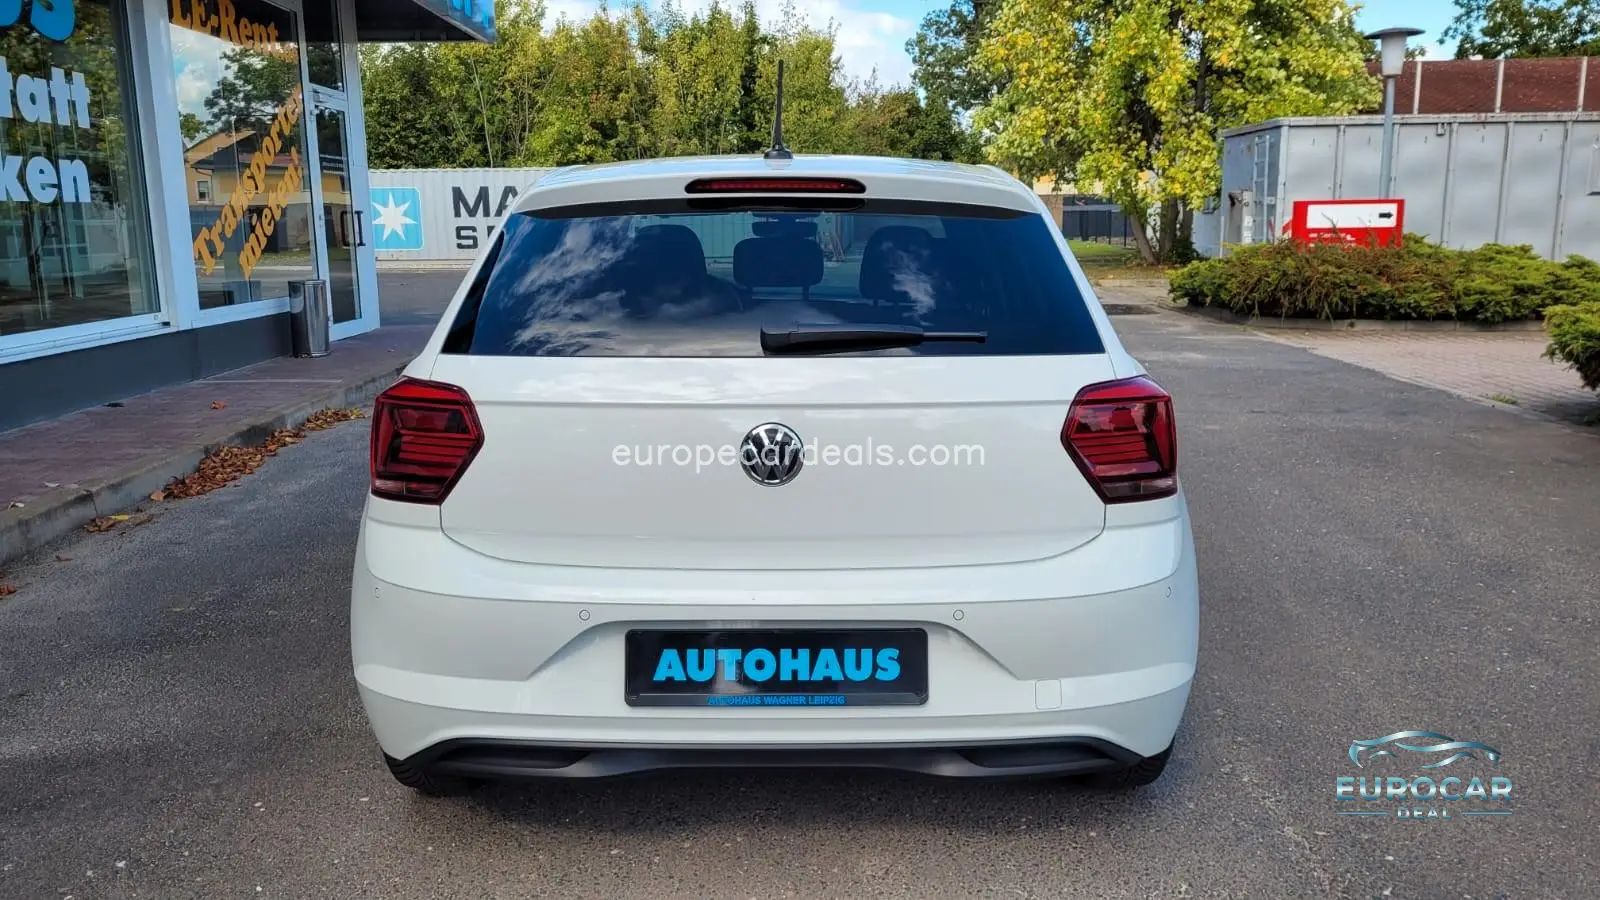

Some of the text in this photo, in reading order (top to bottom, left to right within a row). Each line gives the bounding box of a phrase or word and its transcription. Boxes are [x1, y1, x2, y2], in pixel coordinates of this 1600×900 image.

[193, 83, 304, 275] Transporter
[239, 146, 304, 280] mieten!
[653, 647, 901, 682] AUTOHAUS
[707, 695, 846, 705] AUTOHAUS WAGNER LEIPZIG
